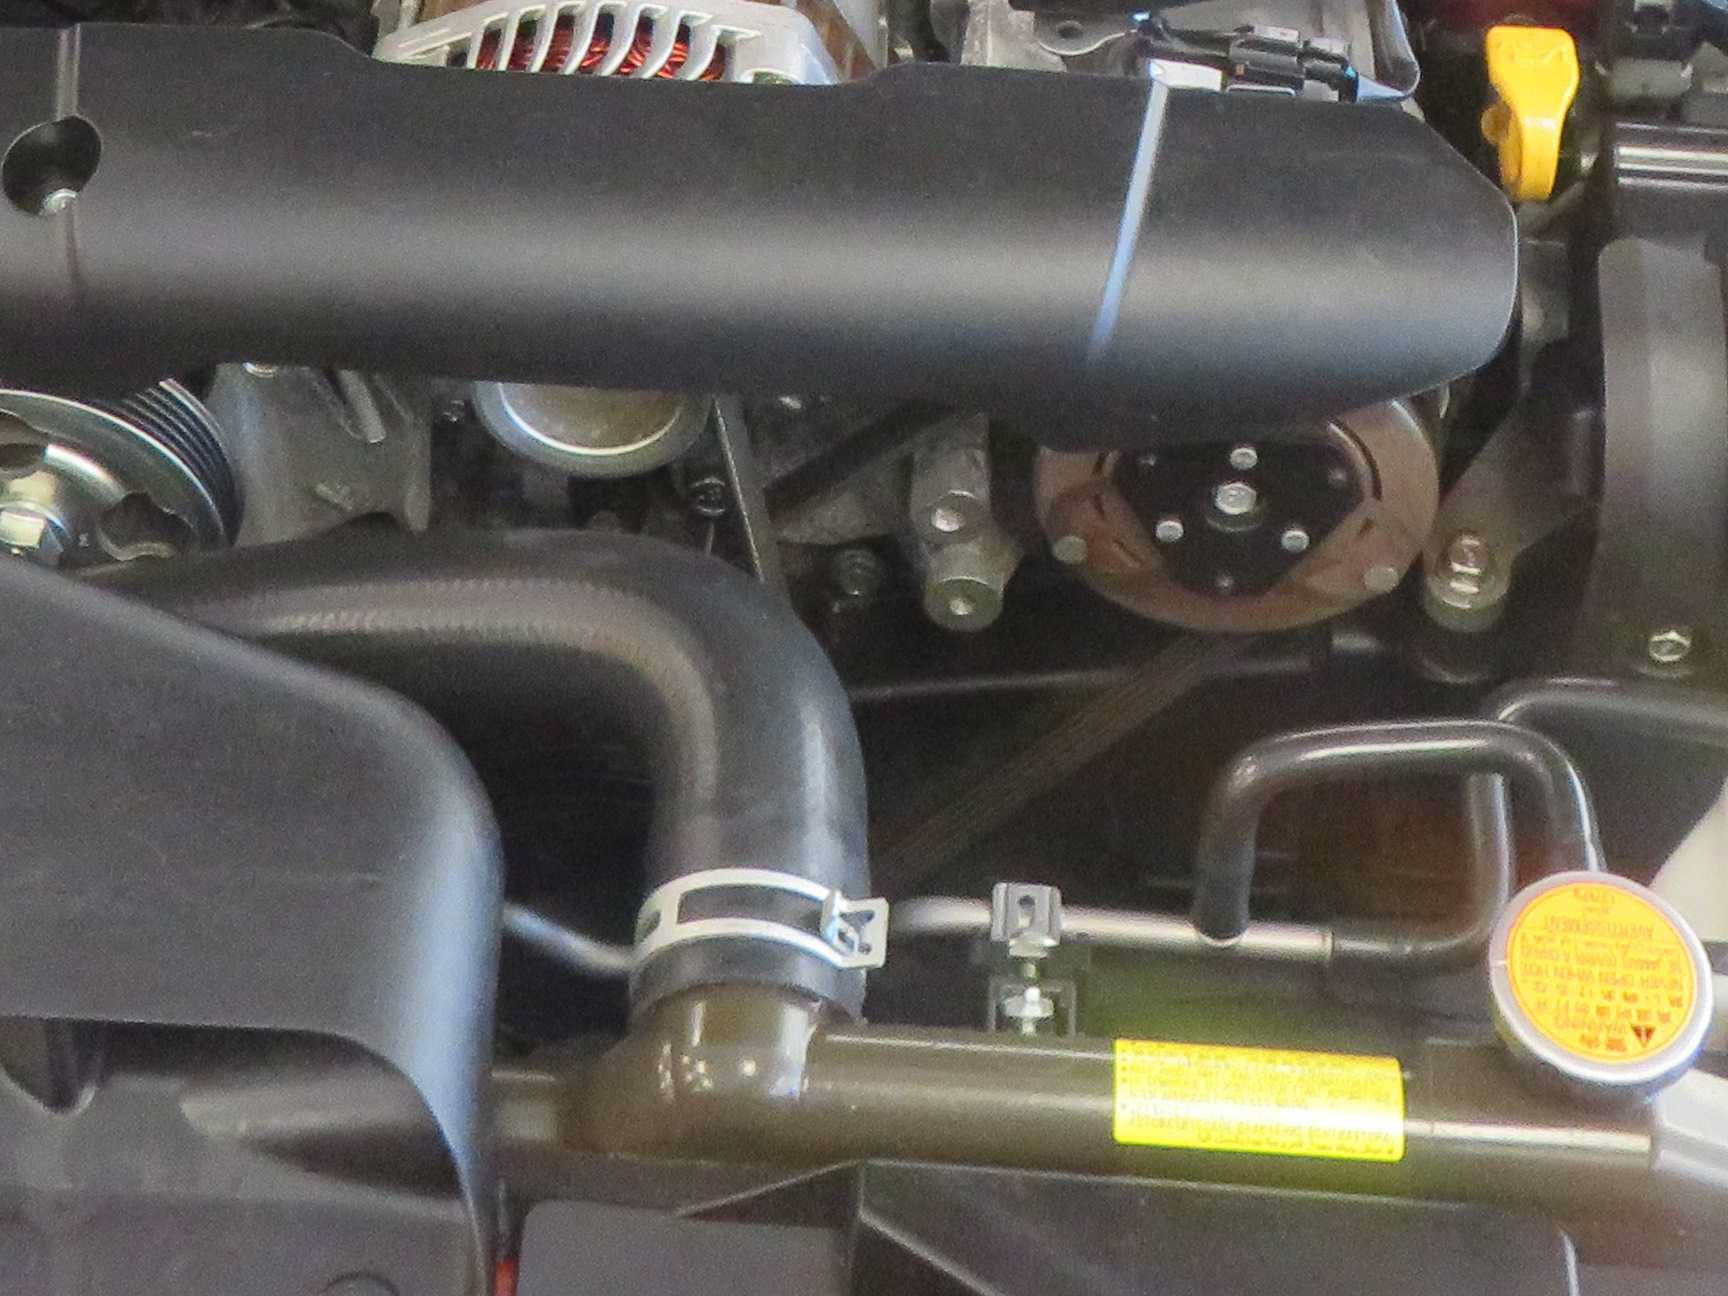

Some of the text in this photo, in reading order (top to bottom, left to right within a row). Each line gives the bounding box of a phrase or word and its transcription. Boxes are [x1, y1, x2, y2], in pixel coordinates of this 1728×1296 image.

[1553, 964, 1594, 983] WHEN
[1598, 971, 1635, 988] OPEN
[1639, 975, 1683, 993] NEVER
